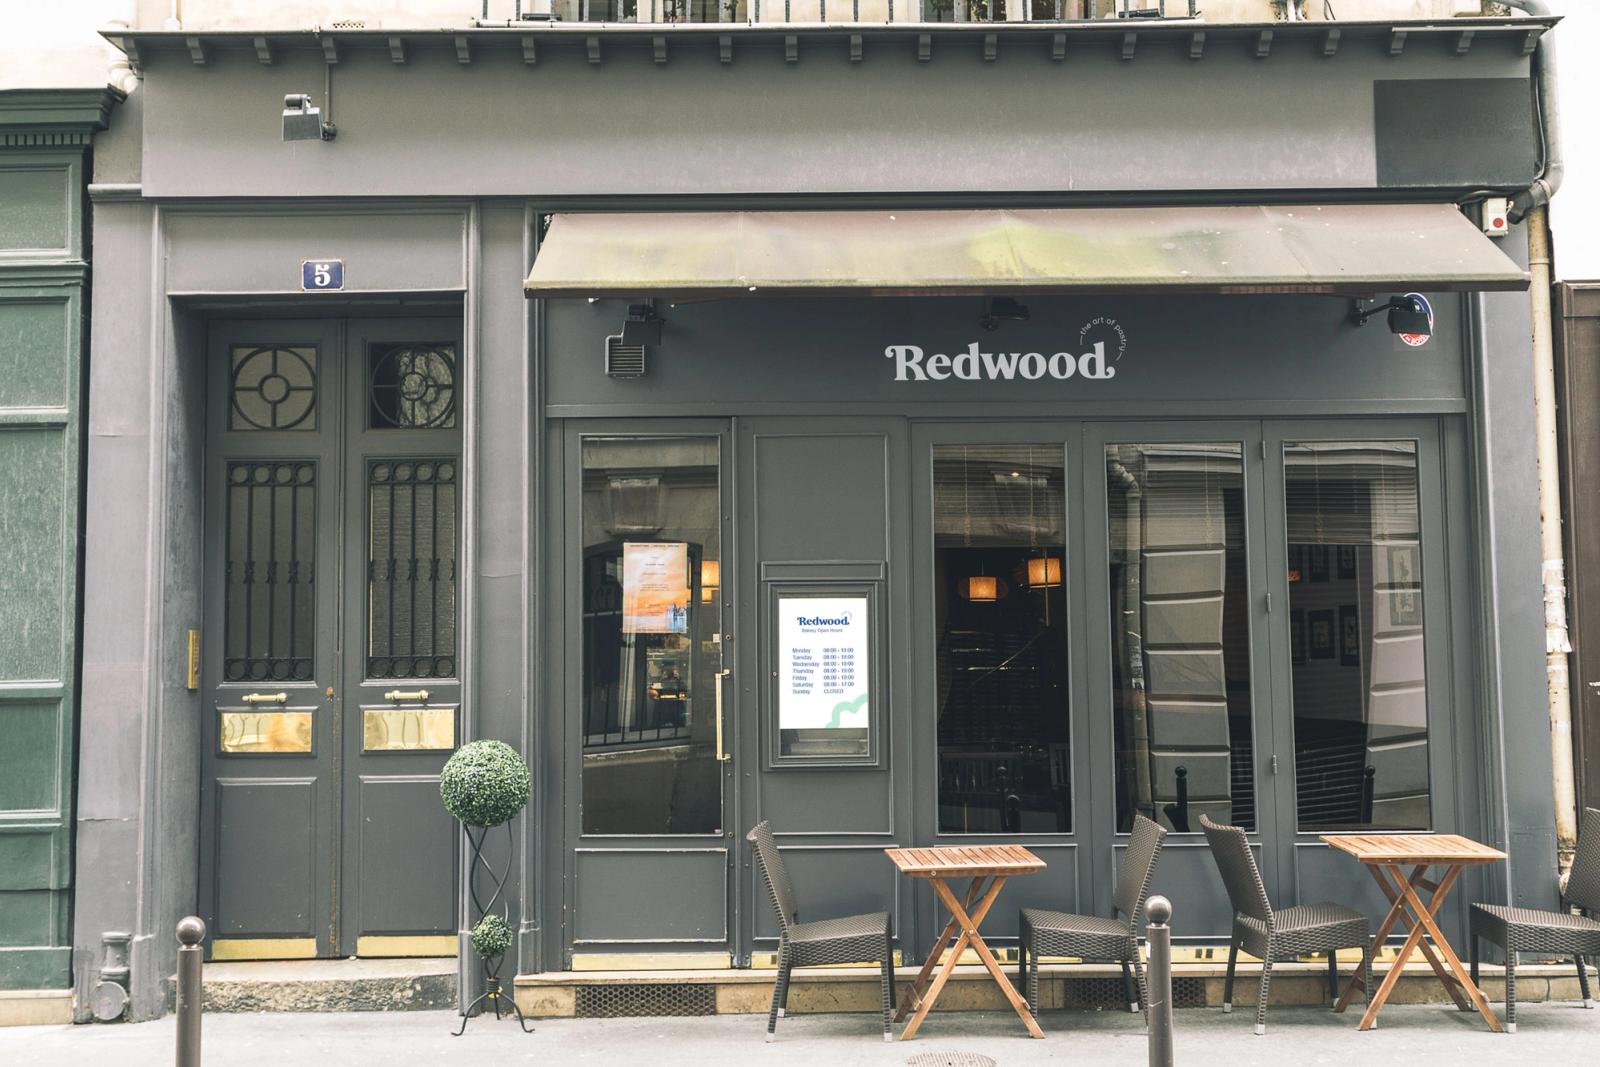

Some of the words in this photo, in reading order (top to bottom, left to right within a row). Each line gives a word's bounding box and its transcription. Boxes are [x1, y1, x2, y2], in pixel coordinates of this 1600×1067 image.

[314, 264, 331, 287] 5
[1080, 323, 1092, 335] the
[1092, 316, 1104, 325] art
[1113, 324, 1127, 351] pastry
[884, 341, 1116, 380] Redwood
